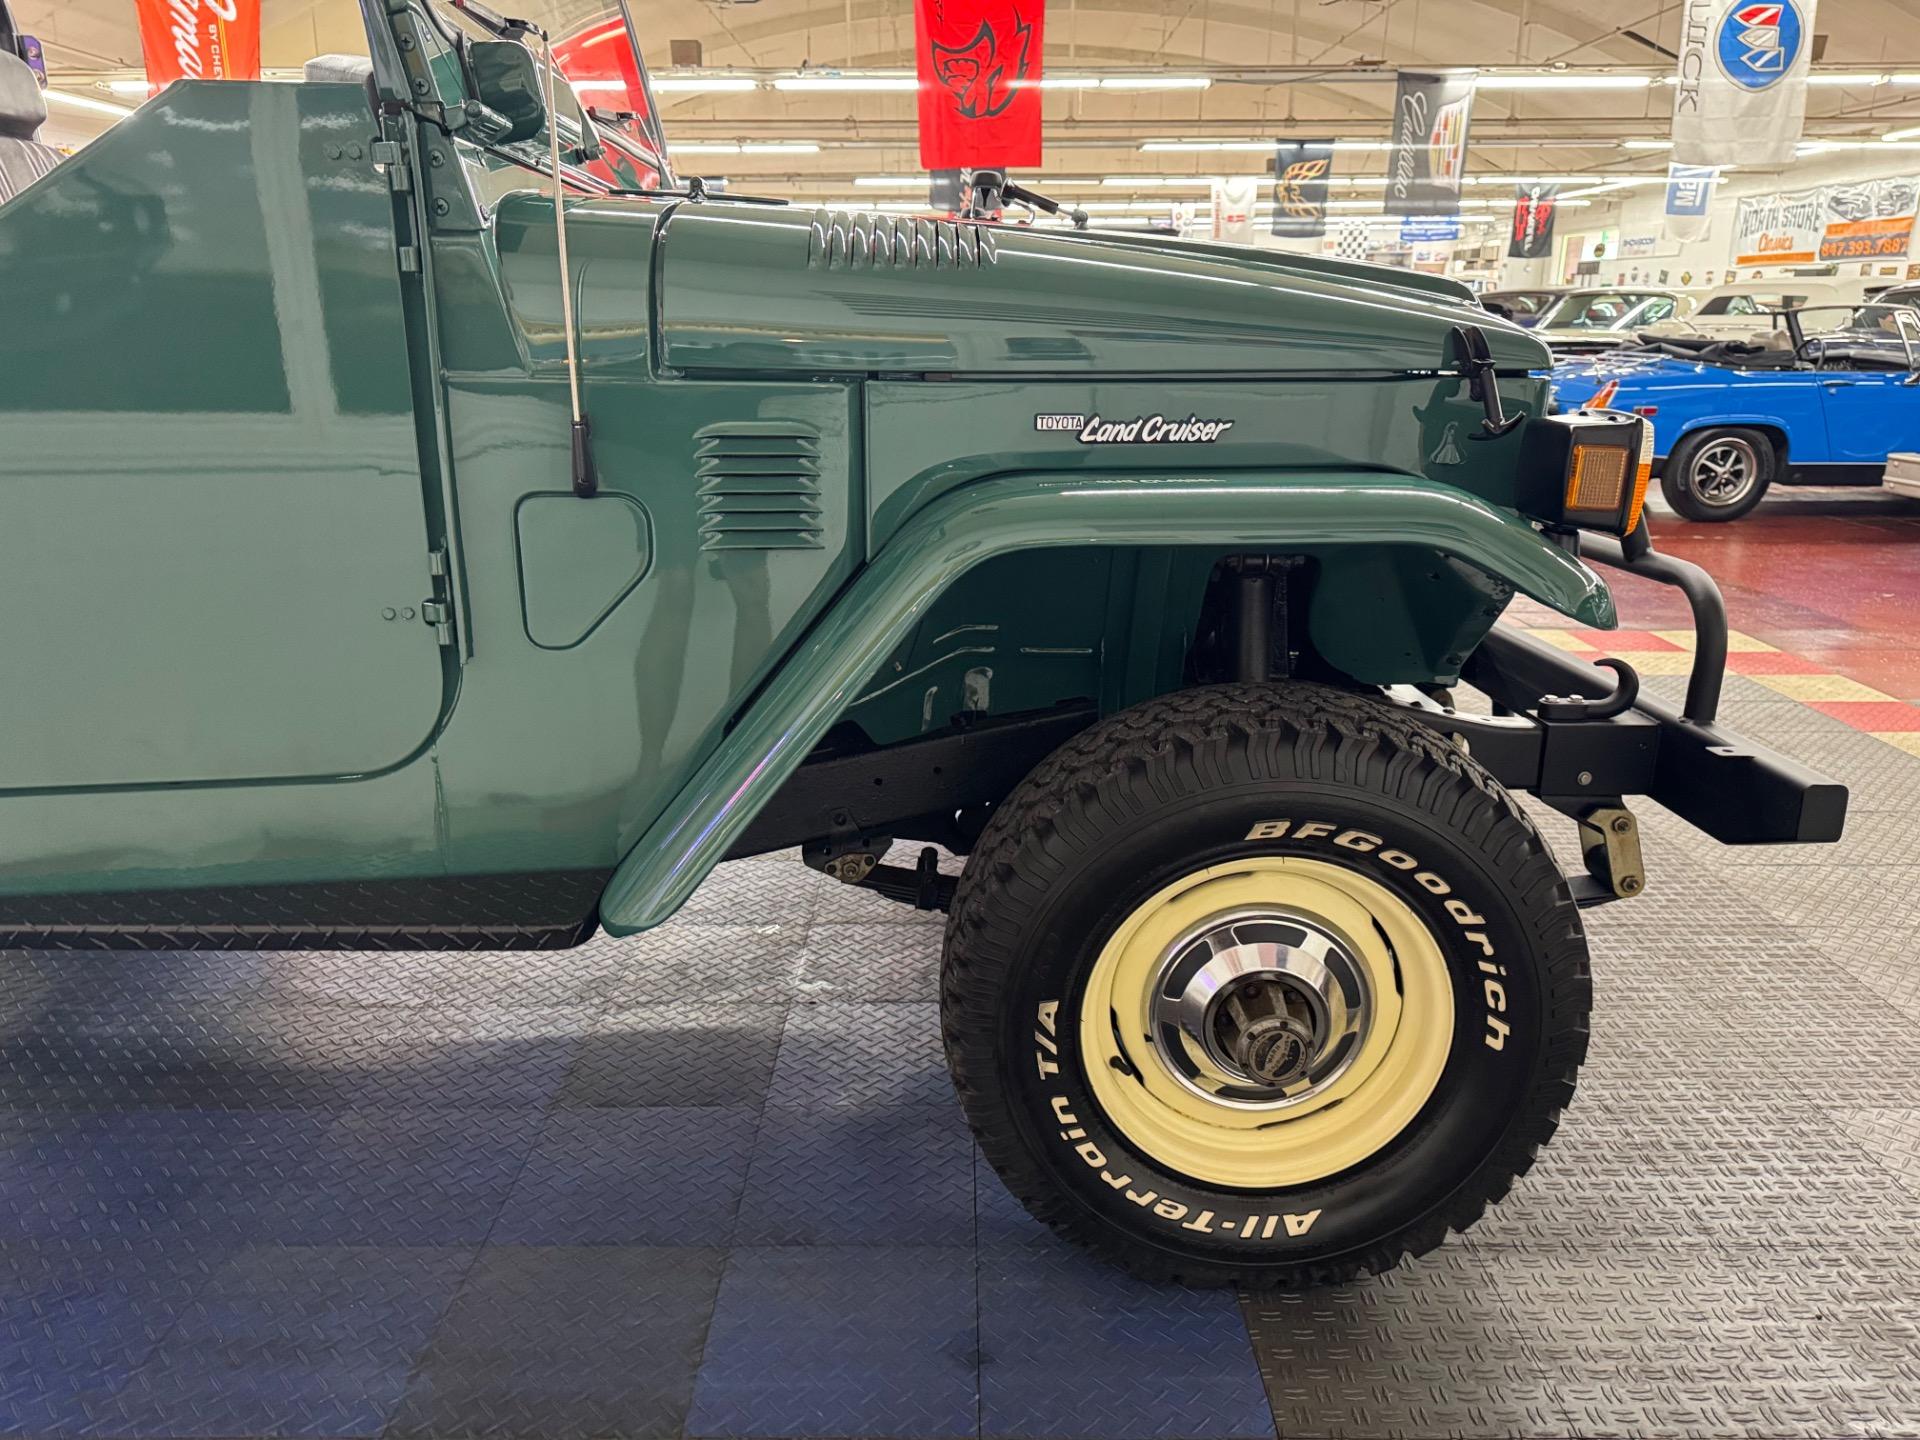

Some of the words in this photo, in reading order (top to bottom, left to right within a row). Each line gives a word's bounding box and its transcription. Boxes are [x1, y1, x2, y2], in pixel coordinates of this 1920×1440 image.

[208, 24, 219, 42] BY
[211, 45, 224, 80] CHEV
[1678, 0, 1711, 112] UICK
[1394, 91, 1427, 199] Cadillac
[1740, 207, 1779, 239] NORTH
[1781, 202, 1823, 233] SHORE
[1038, 416, 1083, 430] TOYOTA
[1079, 416, 1143, 442] Land
[1142, 416, 1234, 442] Cruiser
[1244, 819, 1511, 1052] BFGoodrich
[1033, 1000, 1061, 1081] T/A
[1050, 1096, 1323, 1240] All-Terrain
